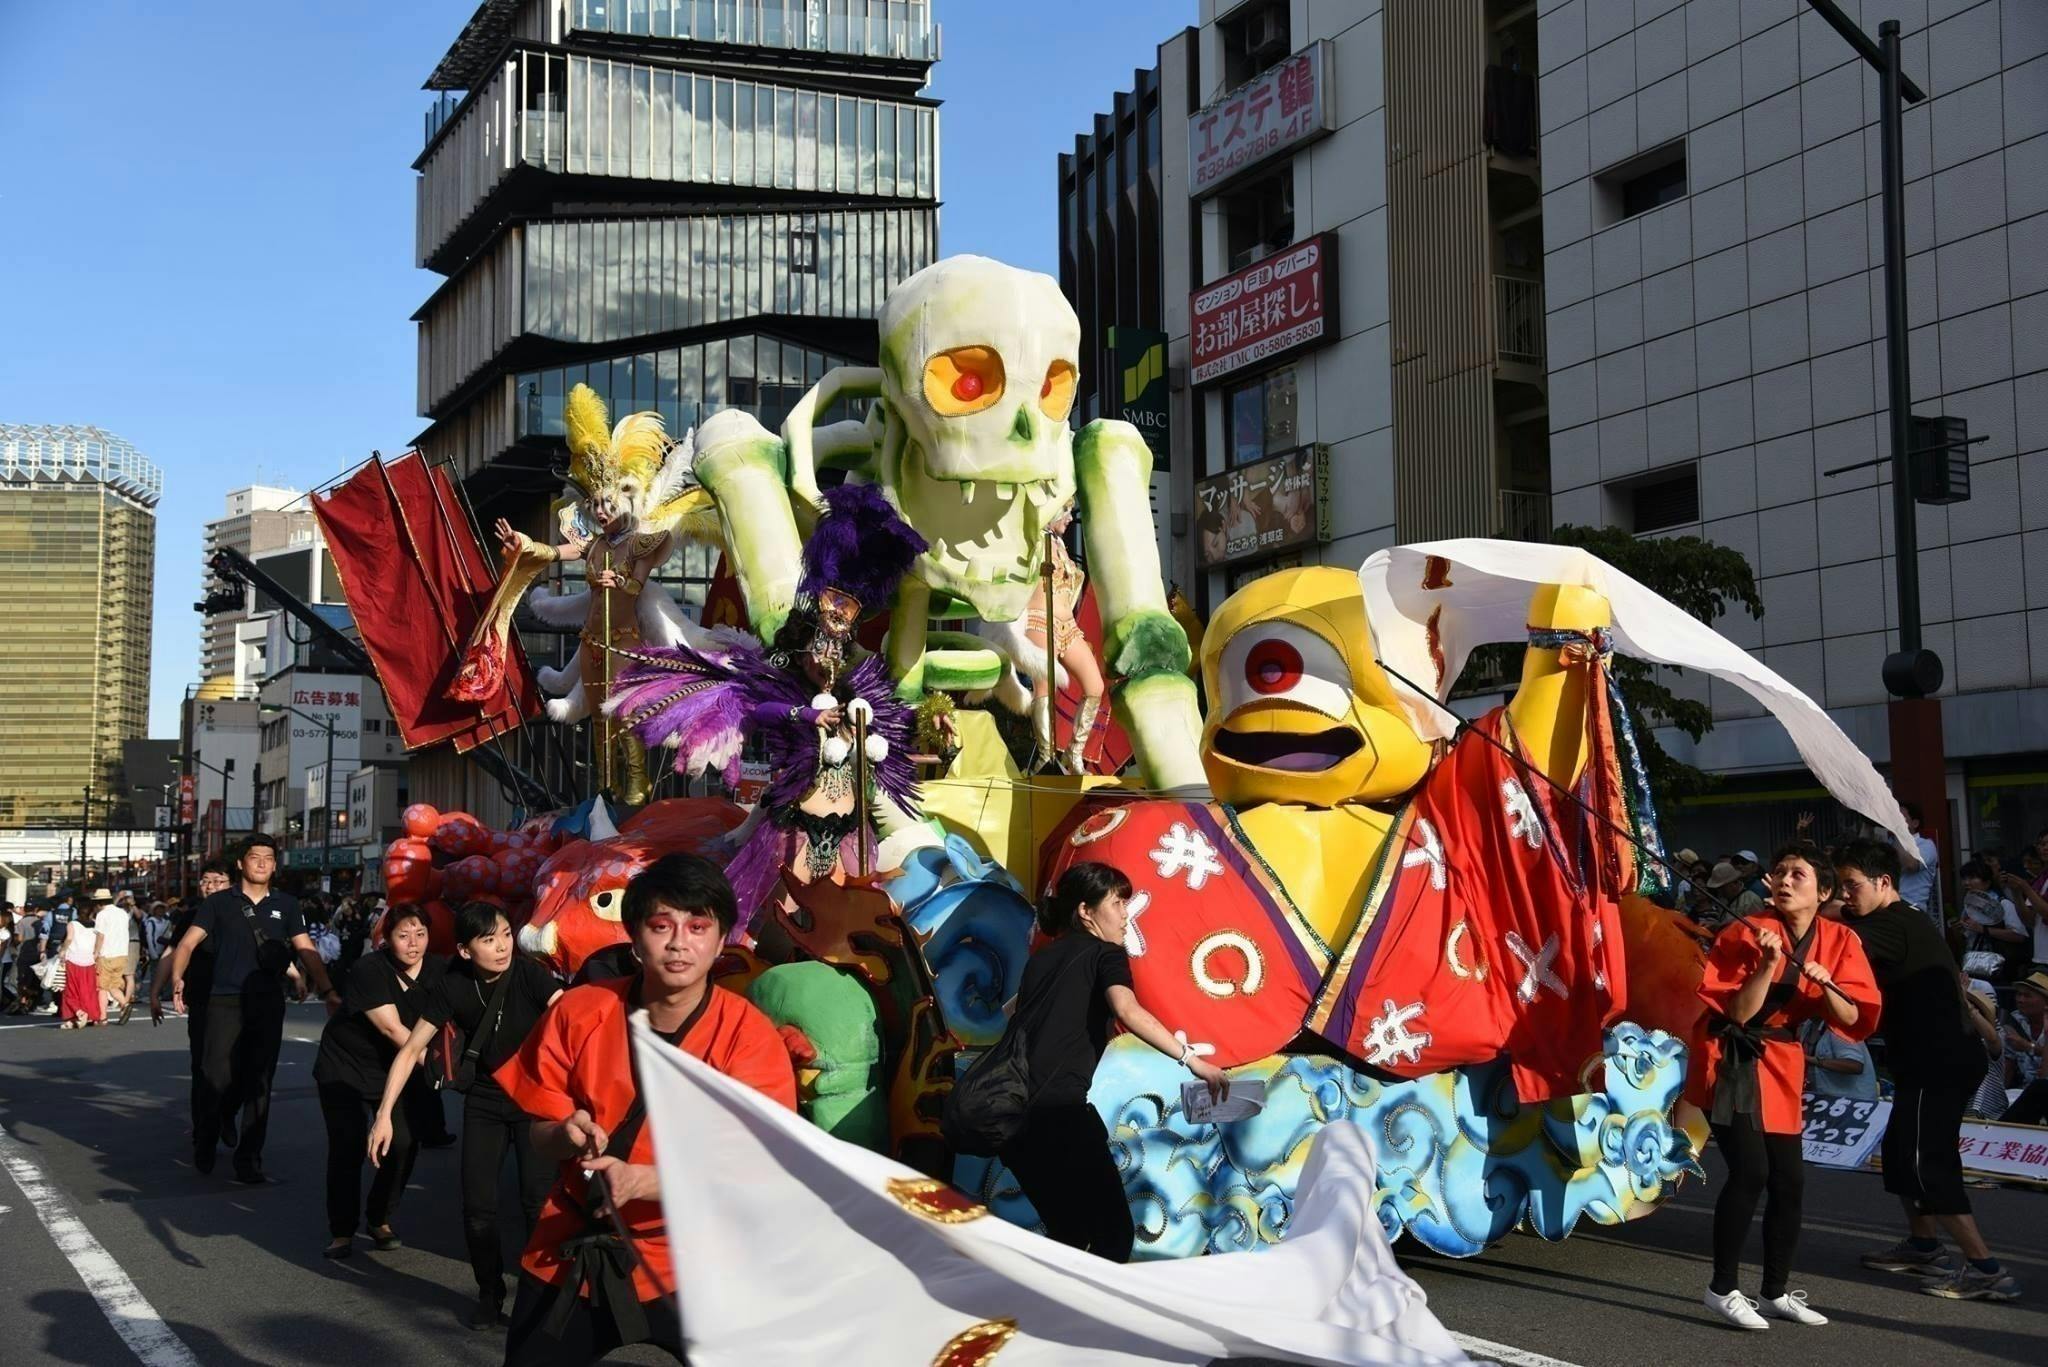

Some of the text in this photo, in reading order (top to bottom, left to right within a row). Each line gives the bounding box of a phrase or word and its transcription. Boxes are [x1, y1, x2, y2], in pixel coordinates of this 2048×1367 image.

[1286, 108, 1312, 139] 4F
[1196, 282, 1241, 312] マンション
[1277, 248, 1316, 277] アパート
[1253, 321, 1321, 359] 03-5806-5830
[1122, 408, 1168, 428] SMBC
[1199, 460, 1286, 513] マッサージ
[293, 690, 360, 708] 広告募集
[293, 729, 358, 739] 03-577-506
[1801, 1119, 1866, 1146] どって
